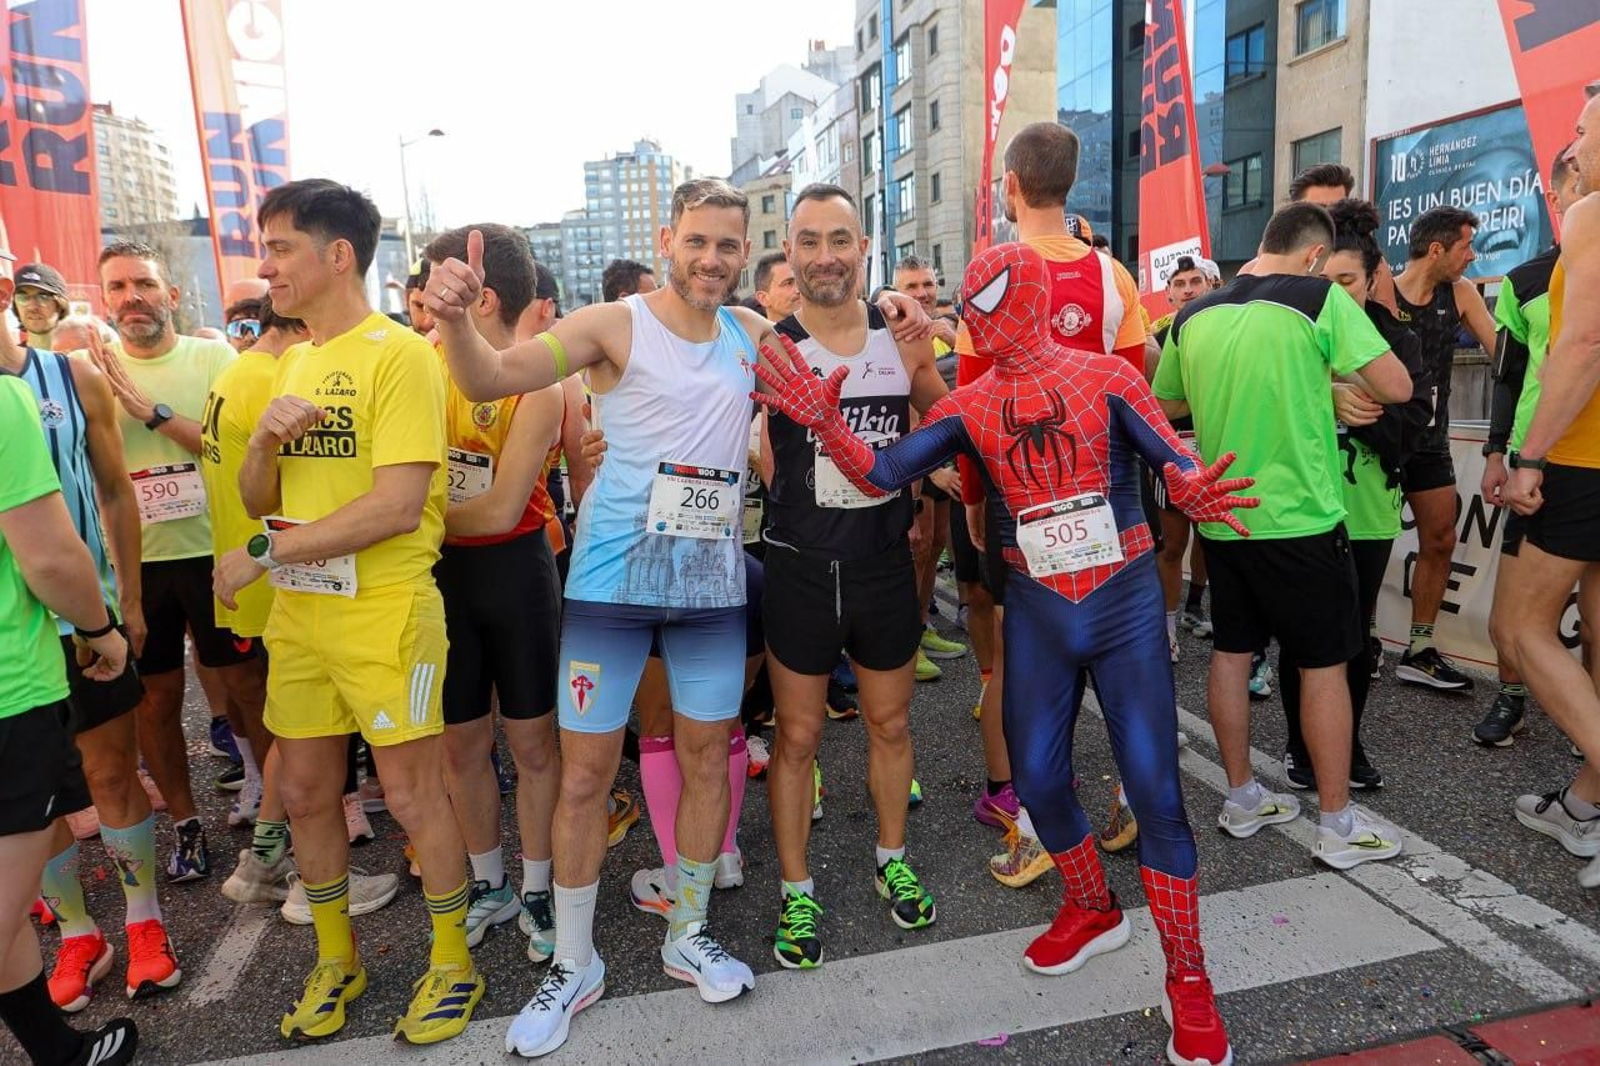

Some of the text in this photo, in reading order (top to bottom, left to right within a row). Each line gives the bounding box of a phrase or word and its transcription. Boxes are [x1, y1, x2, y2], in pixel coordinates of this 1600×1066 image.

[1391, 152, 1406, 183] 10
[203, 111, 257, 257] RUN
[1418, 191, 1444, 214] UN
[1451, 180, 1502, 208] BUEN
[1510, 168, 1544, 200] DÍA
[1472, 205, 1526, 234] REIR!
[142, 481, 179, 501] 590
[680, 486, 719, 510] 266
[1044, 519, 1088, 548] 505
